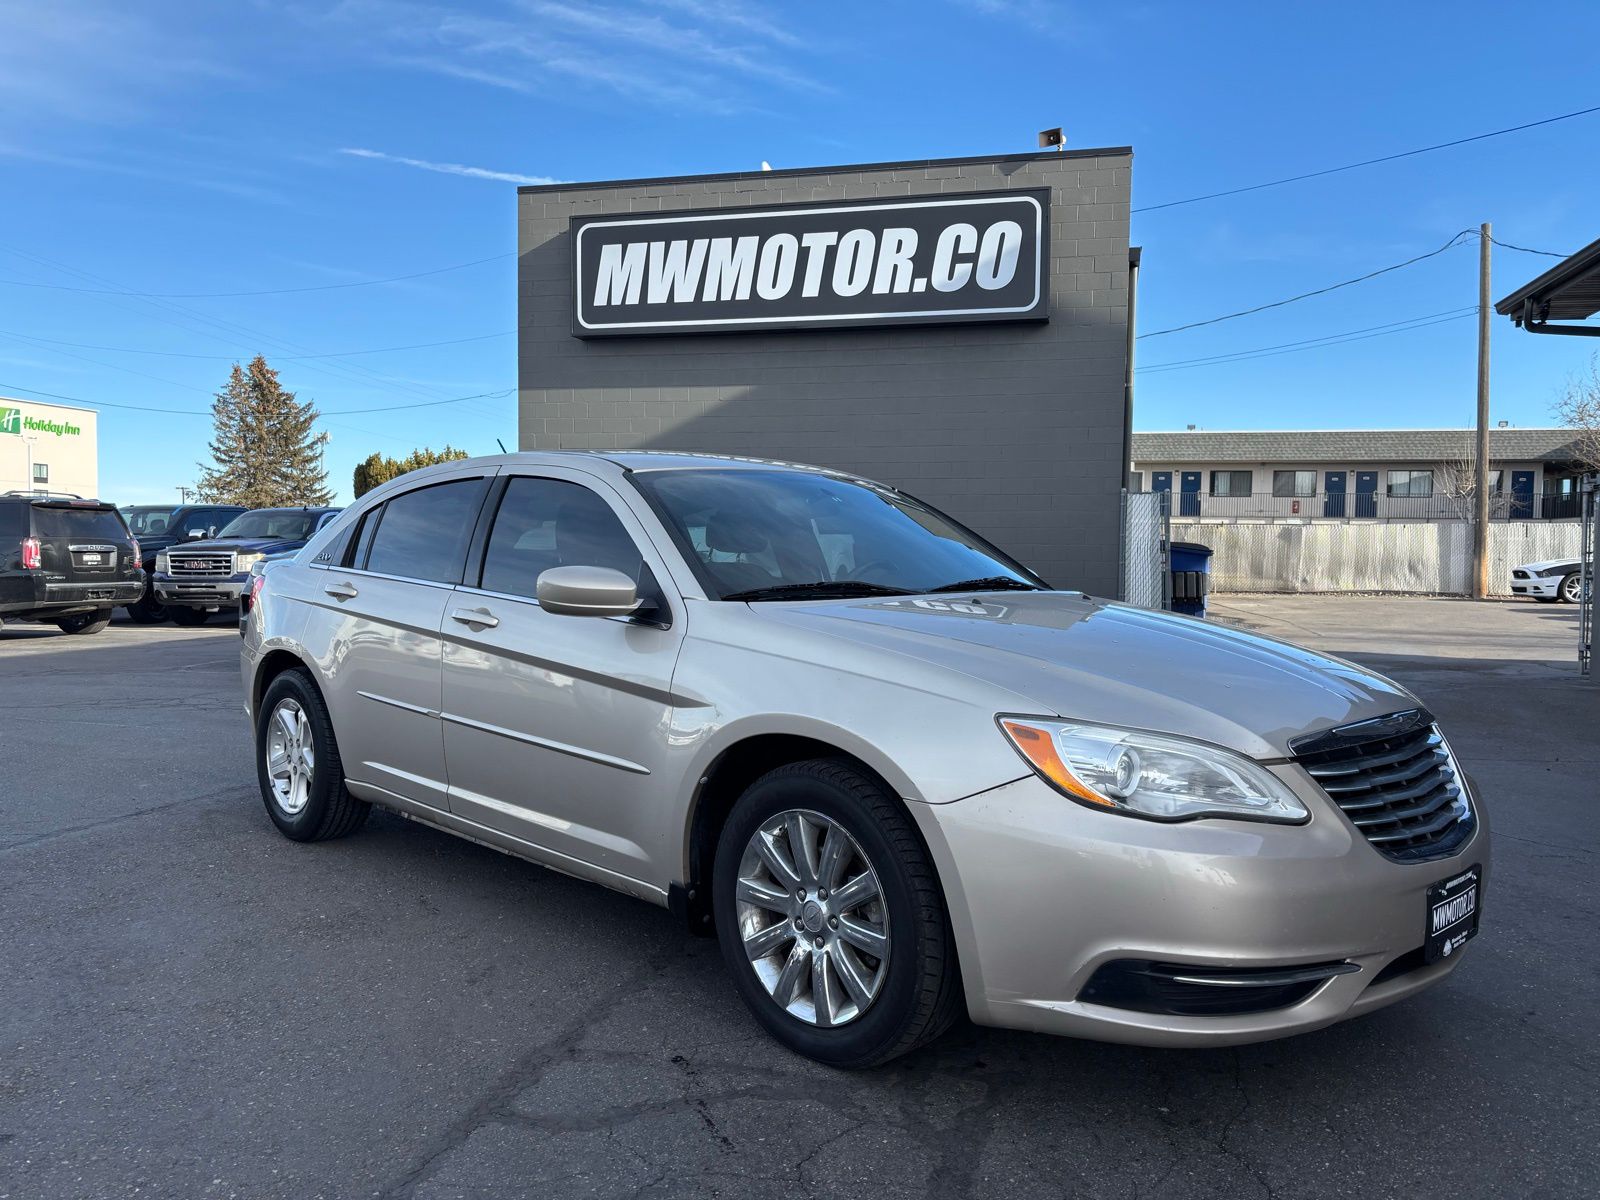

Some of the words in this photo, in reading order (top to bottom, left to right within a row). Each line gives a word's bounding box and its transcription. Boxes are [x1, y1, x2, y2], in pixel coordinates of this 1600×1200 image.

[593, 220, 1023, 307] MWMOTOR.CO
[23, 416, 64, 436] Holiday
[64, 422, 80, 436] Inn
[184, 561, 212, 569] GMC
[1433, 889, 1475, 932] MWMOTOR.CO
